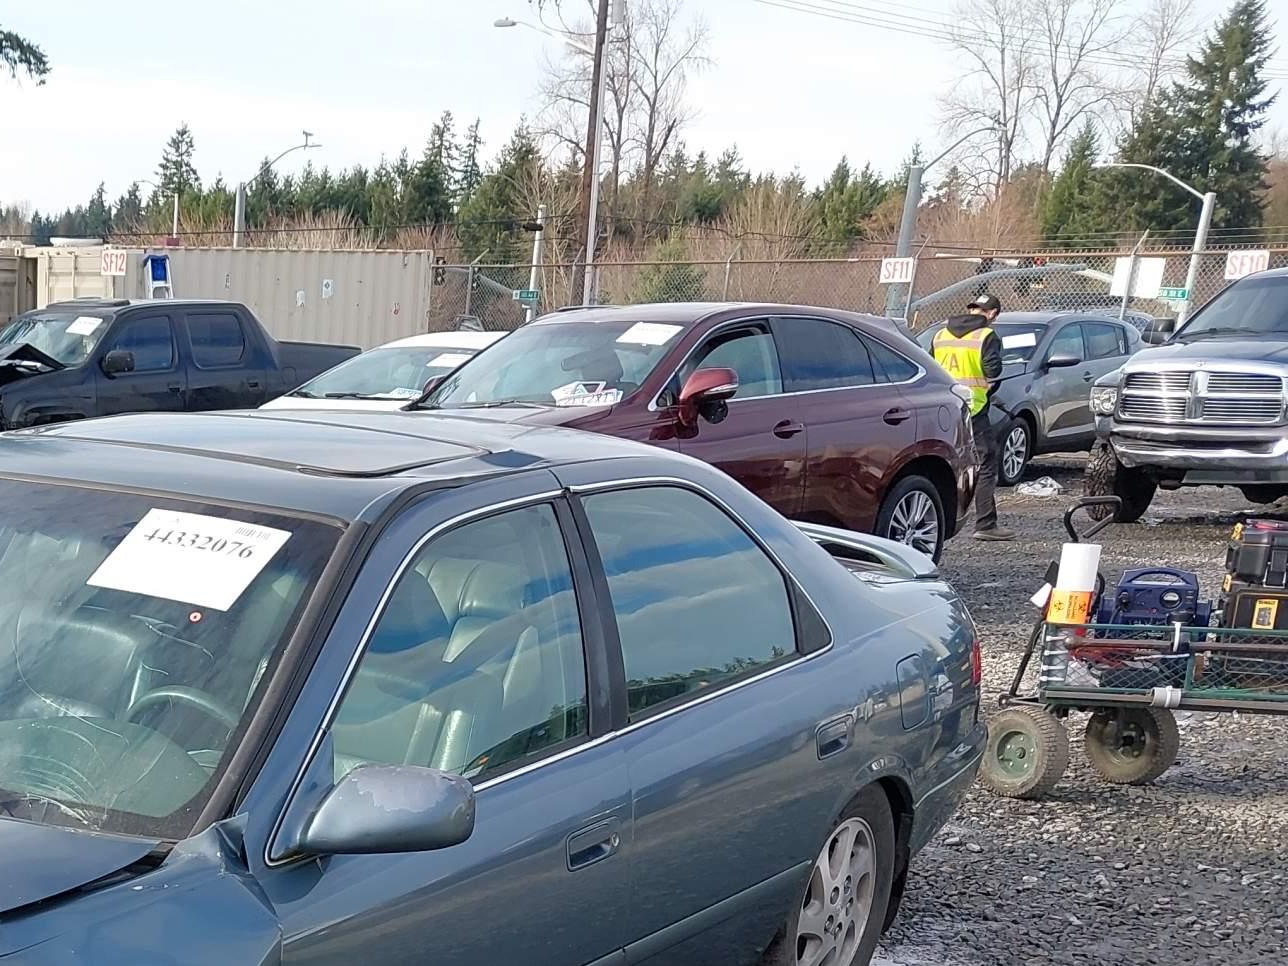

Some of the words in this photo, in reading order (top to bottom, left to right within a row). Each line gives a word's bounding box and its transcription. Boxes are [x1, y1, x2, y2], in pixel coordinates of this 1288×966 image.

[103, 253, 125, 272] SF12
[883, 261, 910, 279] SF11
[144, 528, 256, 558] 44332076
